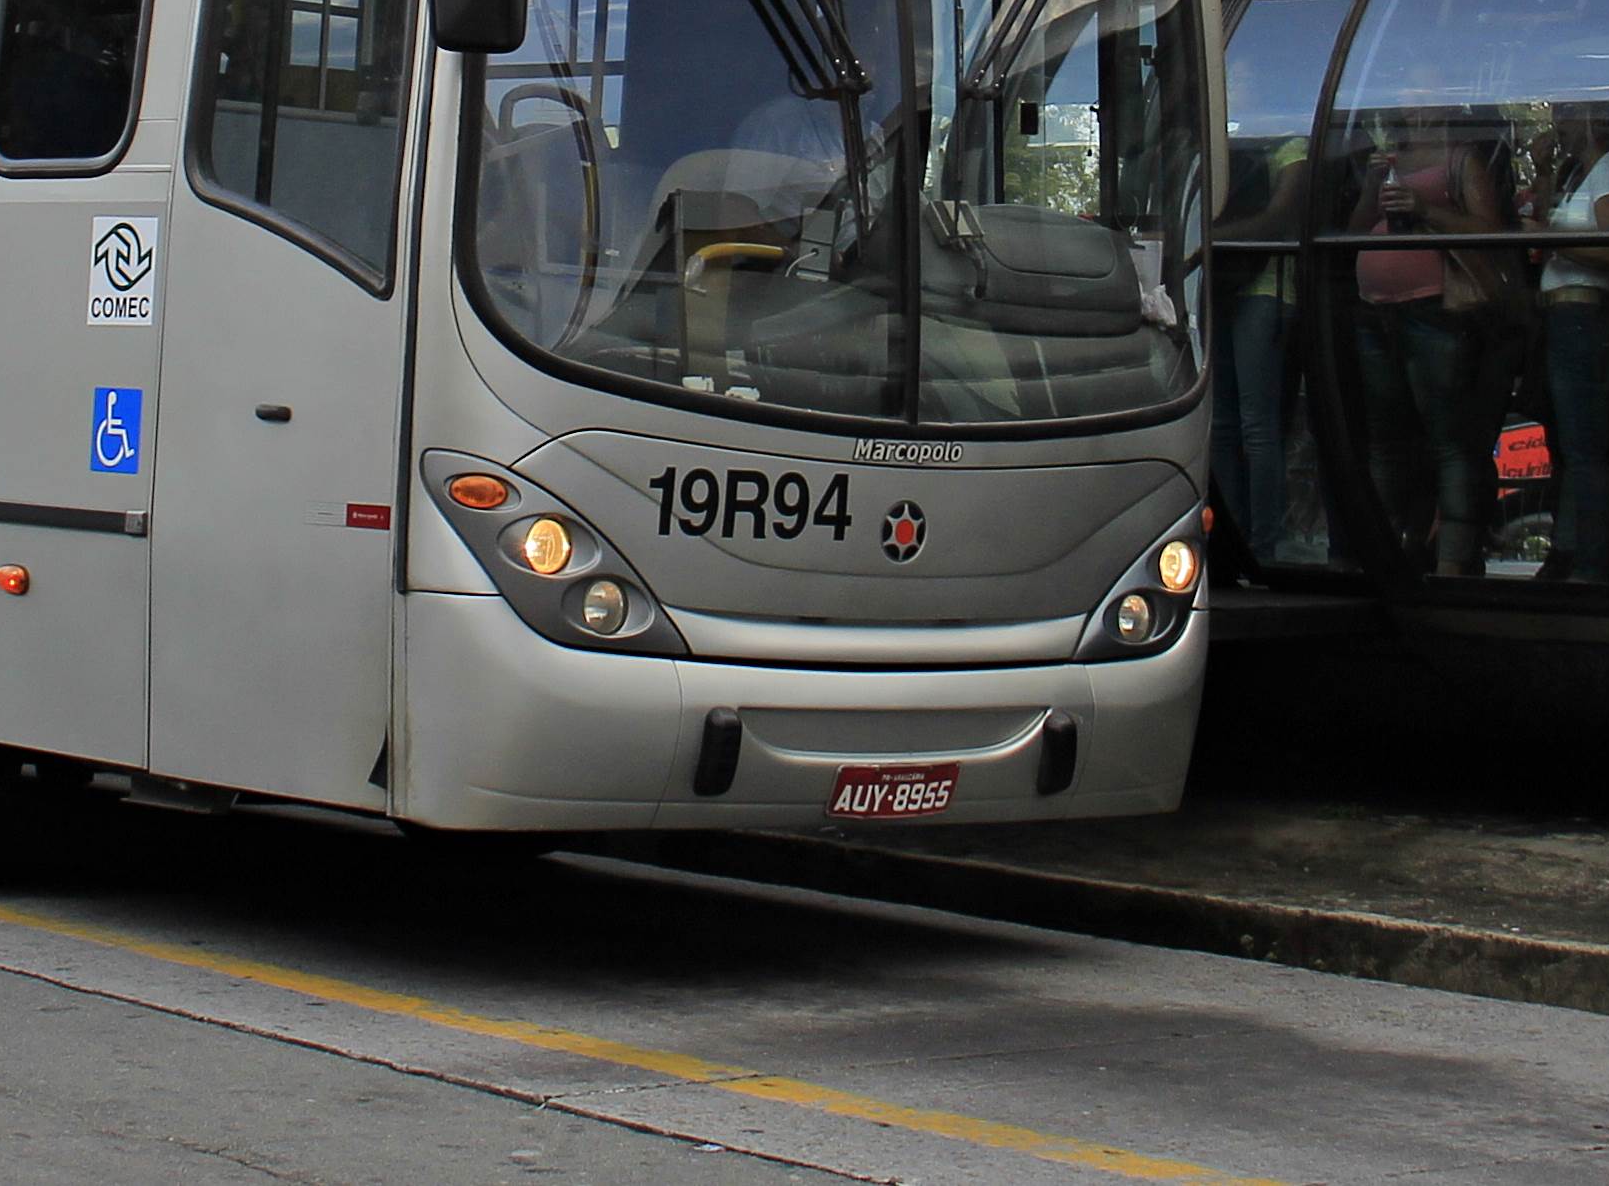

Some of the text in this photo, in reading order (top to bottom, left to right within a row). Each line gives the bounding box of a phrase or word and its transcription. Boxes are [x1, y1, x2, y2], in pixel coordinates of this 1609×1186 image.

[91, 297, 150, 318] COMEC
[853, 437, 964, 464] Marcopolo
[649, 466, 853, 541] 19R94
